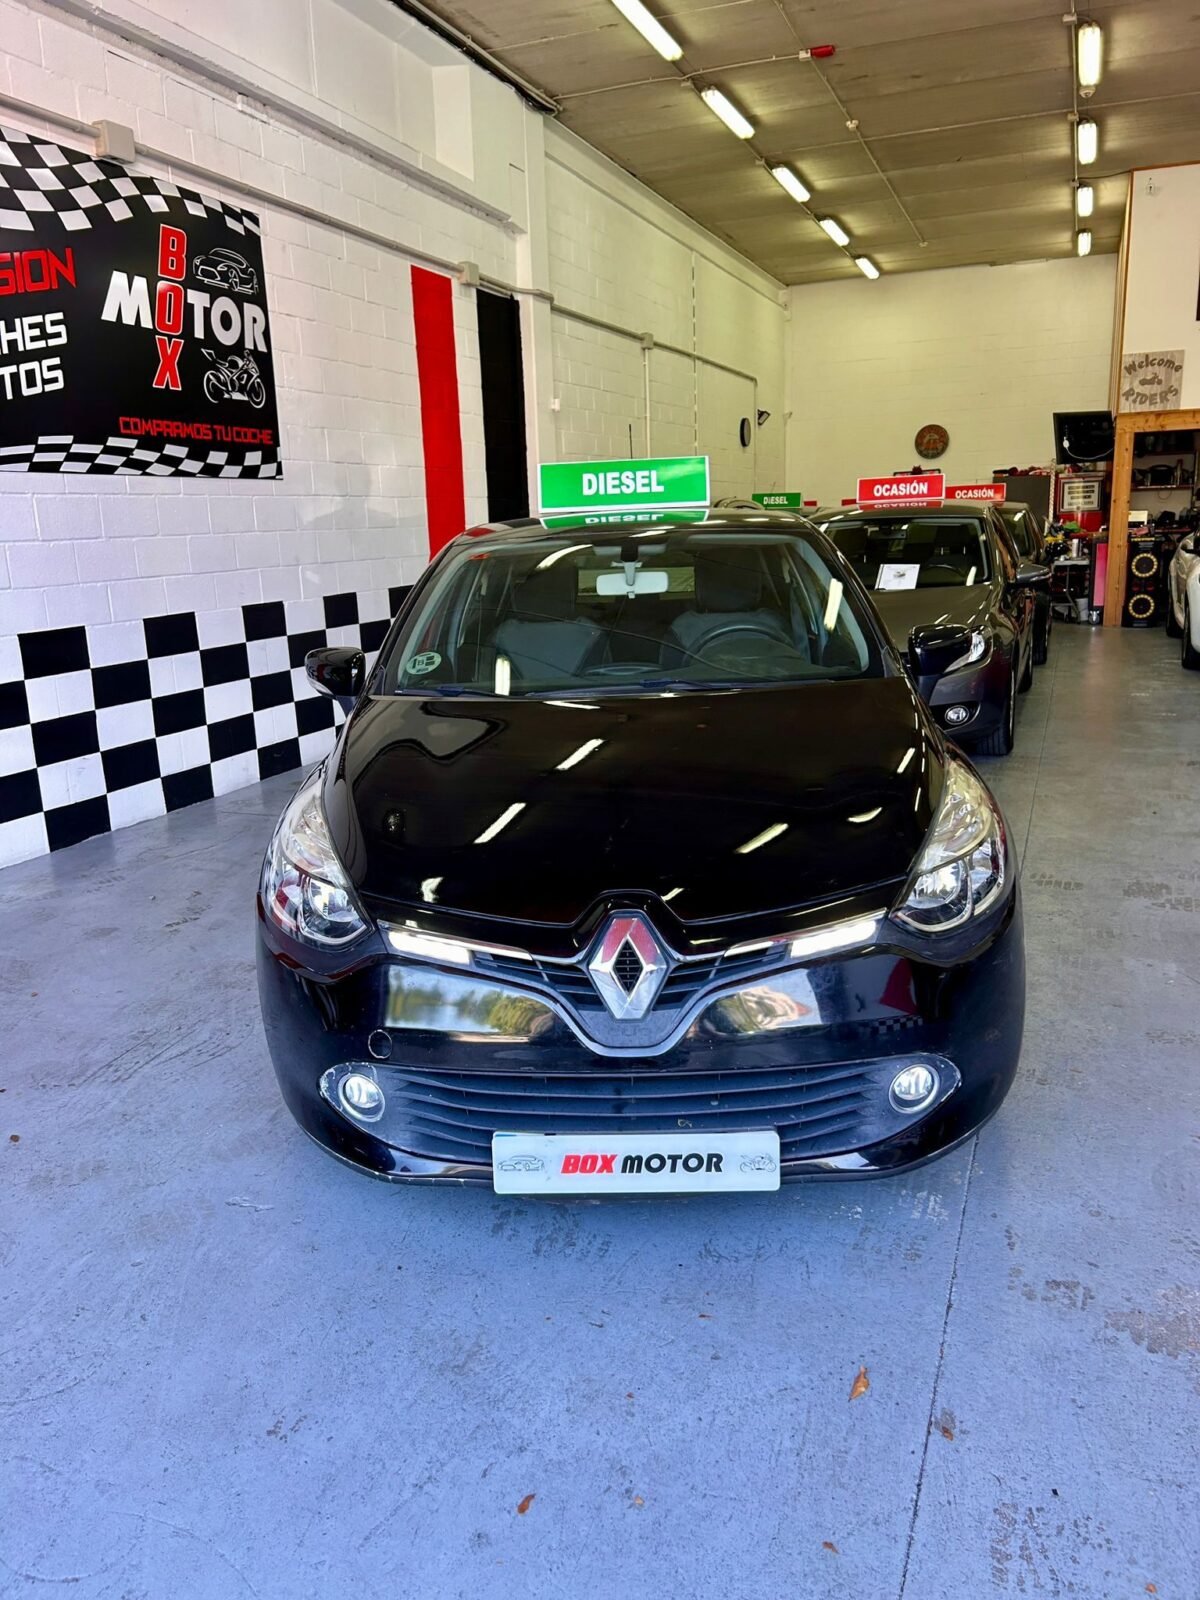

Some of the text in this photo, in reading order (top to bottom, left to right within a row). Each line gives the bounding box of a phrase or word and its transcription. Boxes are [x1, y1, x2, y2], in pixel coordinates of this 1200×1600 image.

[101, 269, 269, 352] MOTOR
[153, 223, 188, 391] BOX
[0, 312, 68, 355] HES
[1124, 354, 1183, 375] Welcome
[0, 357, 65, 400] TOS
[1122, 385, 1179, 406] RIDERS
[119, 416, 273, 444] COMPRAMOS TU COCHE
[582, 470, 665, 496] DIESEL
[873, 480, 928, 497] OCASIÓN
[955, 487, 994, 499] OCASIÓN
[763, 496, 788, 505] DIESEL
[561, 1152, 723, 1174] BOX MOTOR
